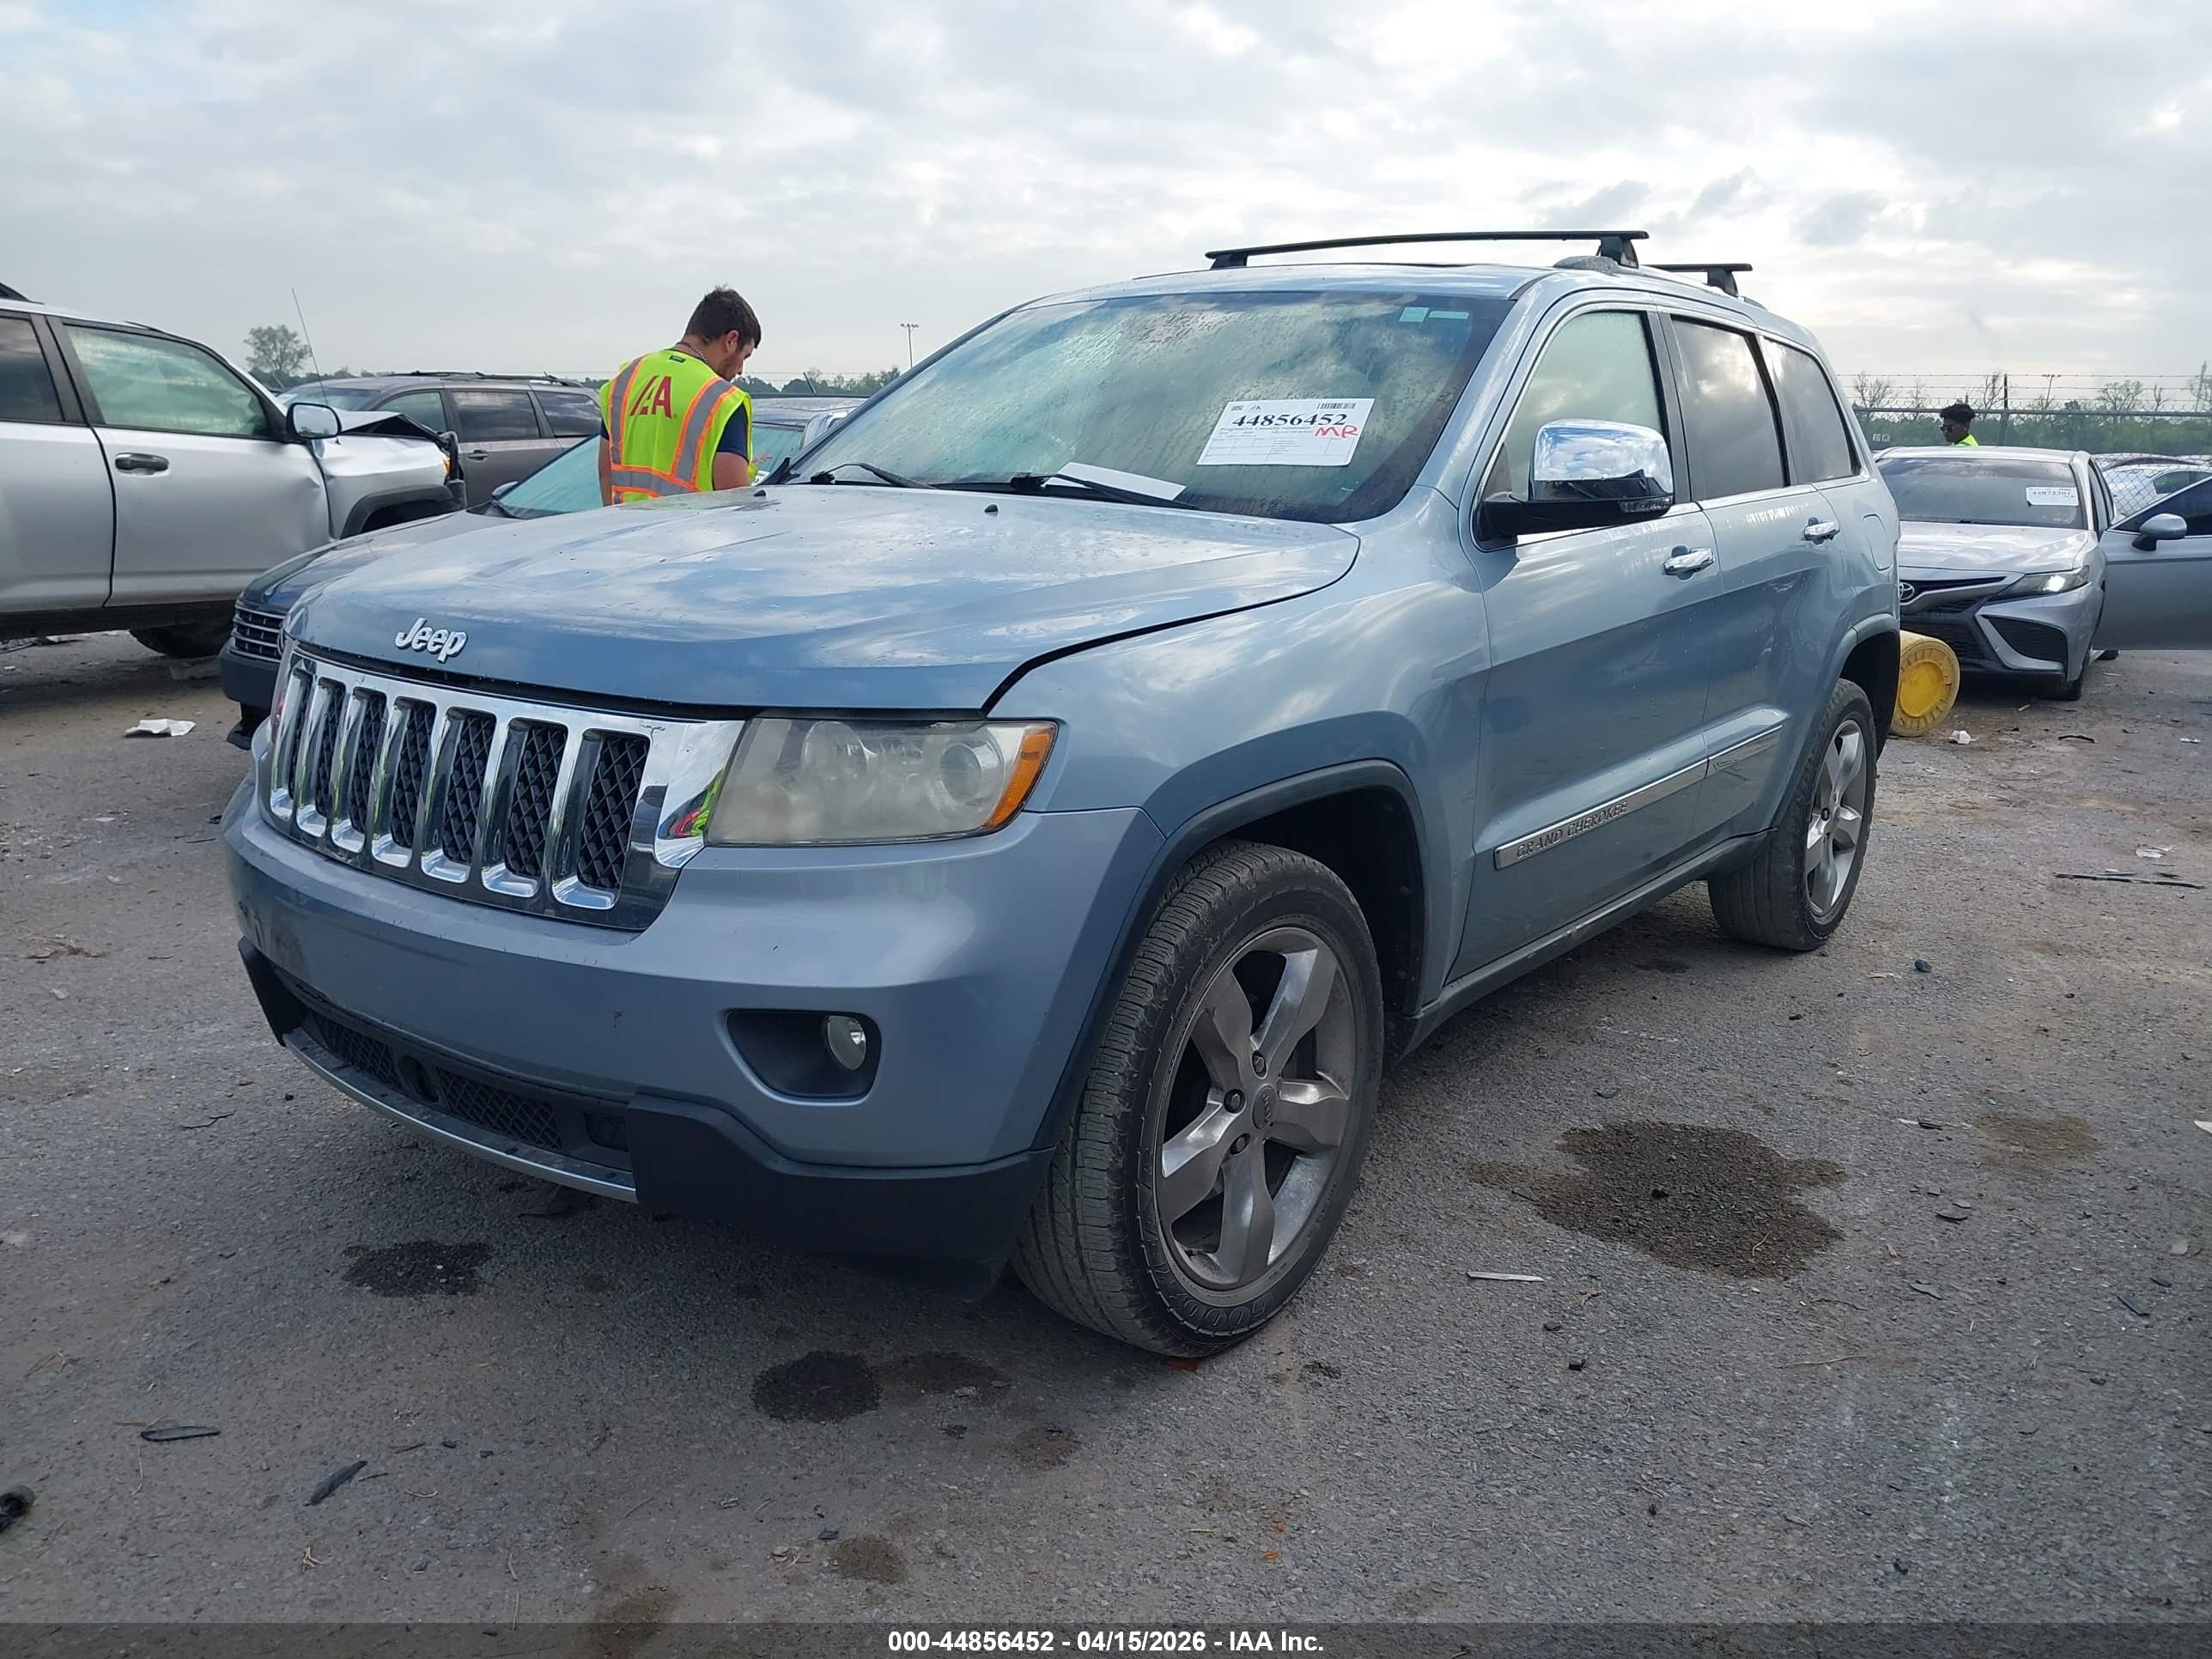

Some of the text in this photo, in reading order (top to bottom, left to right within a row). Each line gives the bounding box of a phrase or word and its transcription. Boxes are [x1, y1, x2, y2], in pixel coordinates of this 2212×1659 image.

[1232, 413, 1347, 427] 44856452
[395, 617, 467, 664] Jeep
[1516, 801, 1628, 859] GRAND CHEROKEE
